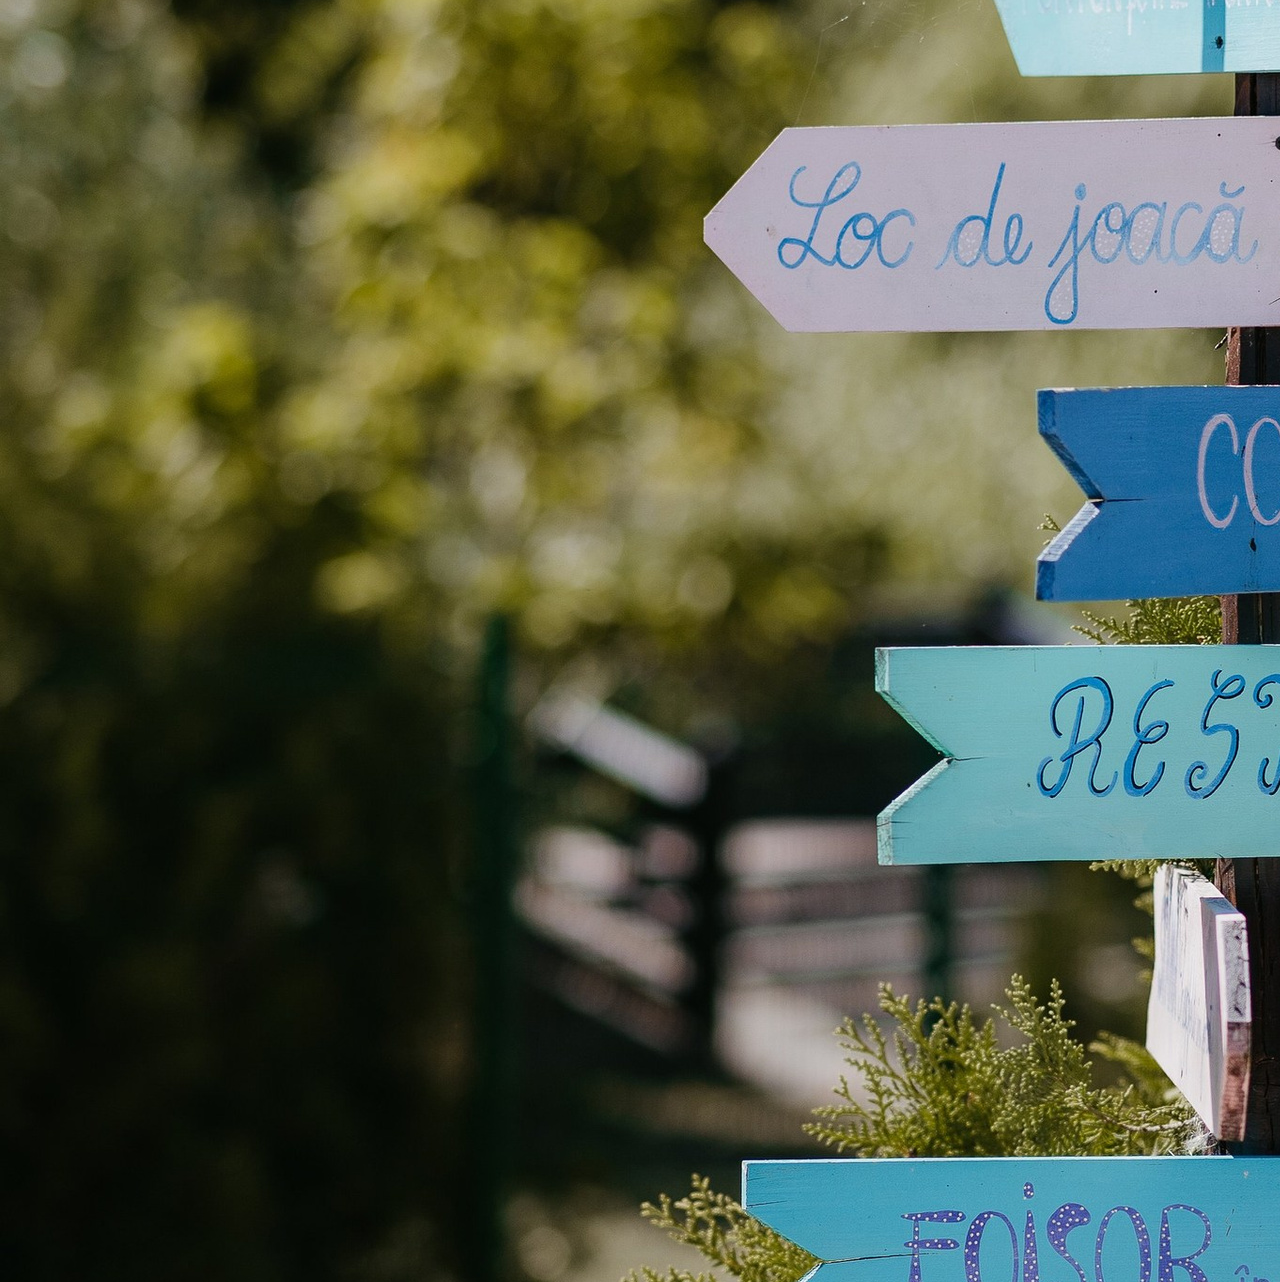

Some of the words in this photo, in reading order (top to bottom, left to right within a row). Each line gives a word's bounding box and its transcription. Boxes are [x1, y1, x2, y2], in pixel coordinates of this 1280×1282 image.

[777, 161, 916, 269] Loc
[935, 162, 1033, 268] de
[1044, 182, 1259, 325] joacă
